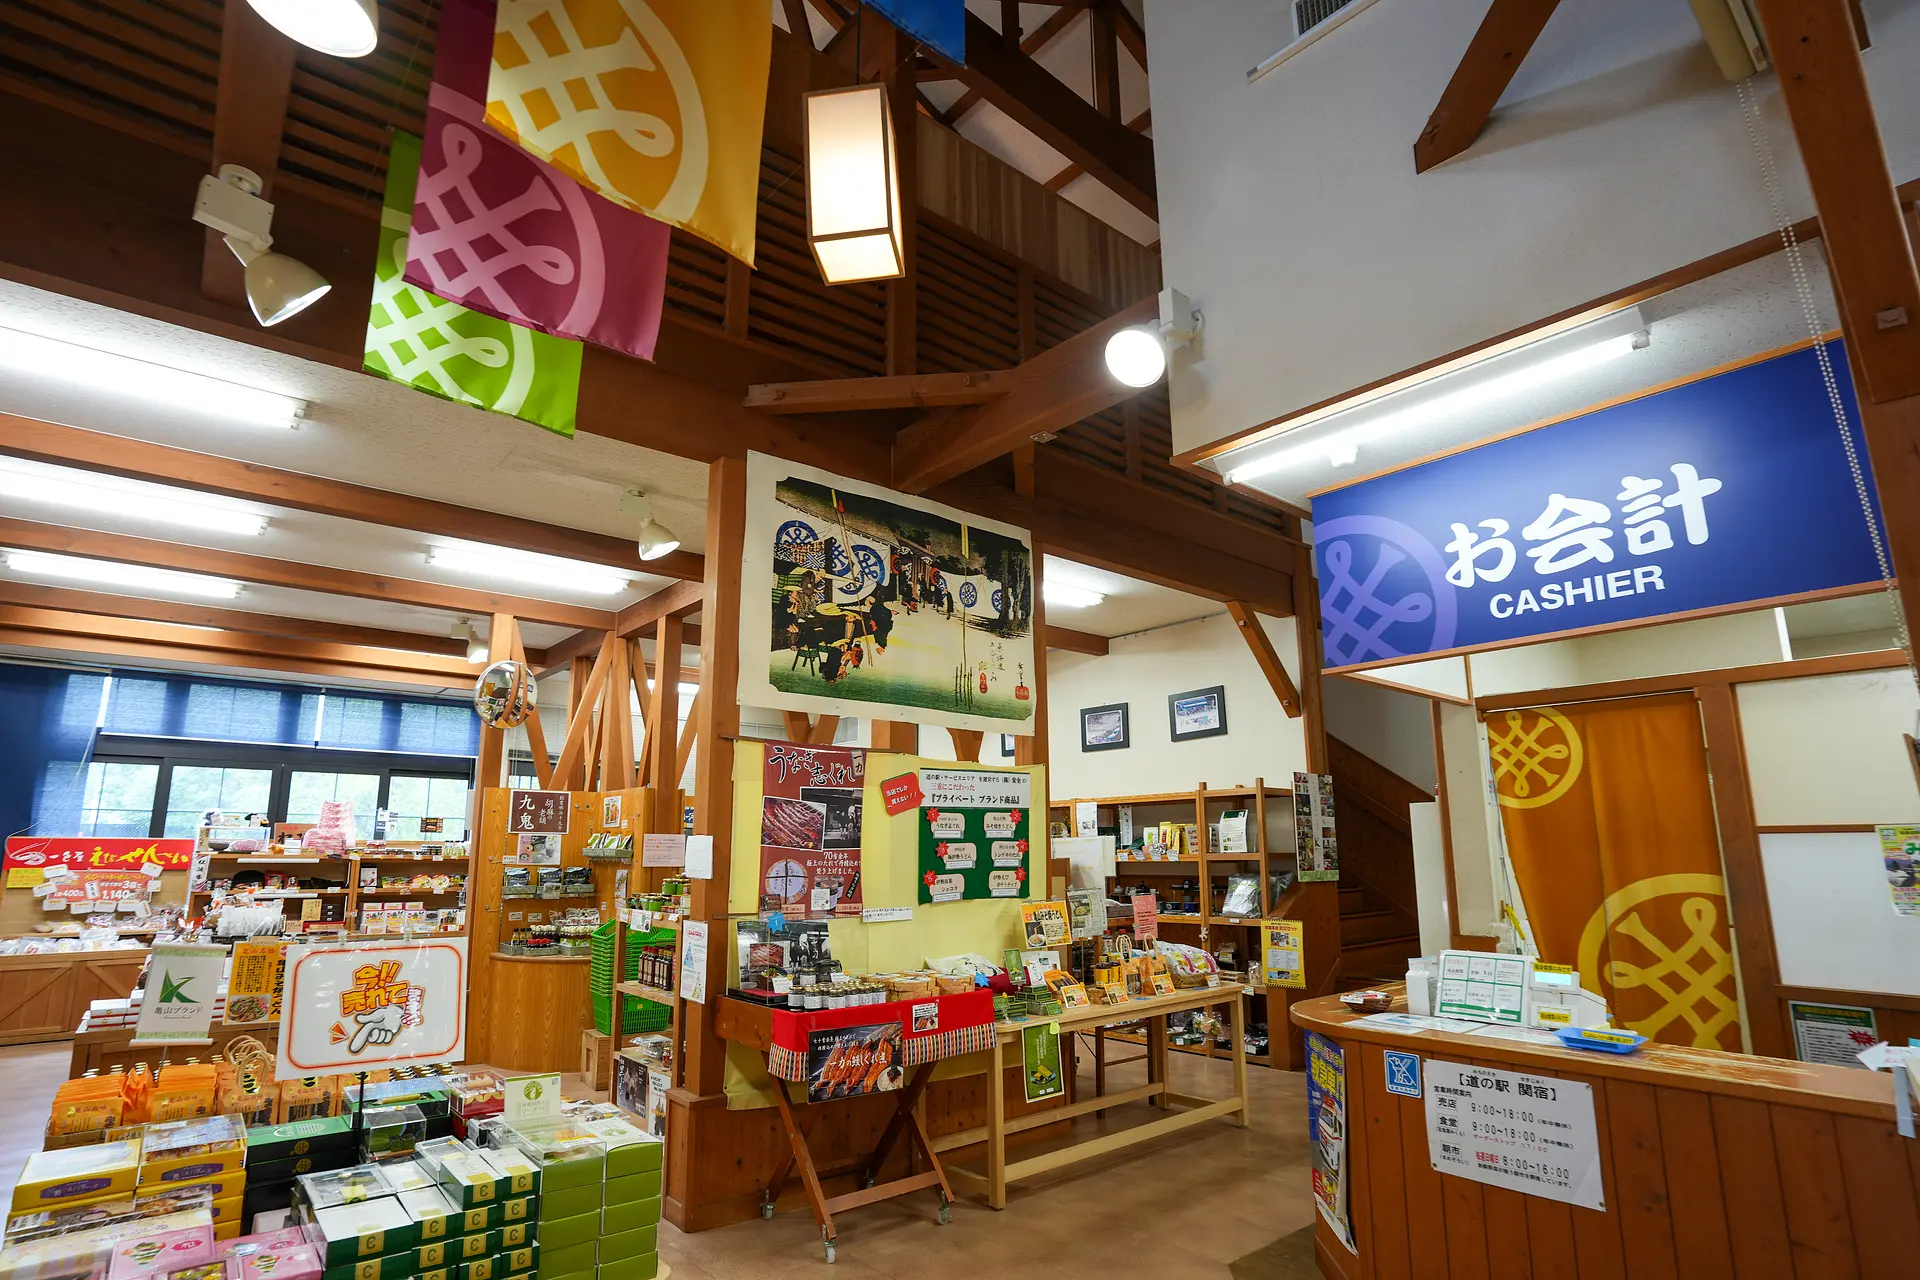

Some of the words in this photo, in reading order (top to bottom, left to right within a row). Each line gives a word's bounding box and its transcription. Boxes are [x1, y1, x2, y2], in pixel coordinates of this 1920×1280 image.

[1444, 463, 1722, 588] お会計
[1488, 565, 1666, 620] CASHIER
[517, 794, 536, 830] 九鬼
[341, 981, 410, 1015] 売れて
[154, 1006, 204, 1015] 亀山ブランド
[1433, 1085, 1472, 1098] 営業時間案内
[1458, 1073, 1510, 1094] 【道の駅
[1518, 1082, 1557, 1101] 関宿】
[1438, 1097, 1457, 1109] 売店
[1439, 1116, 1458, 1128] 食堂
[1442, 1143, 1460, 1156] 朝市
